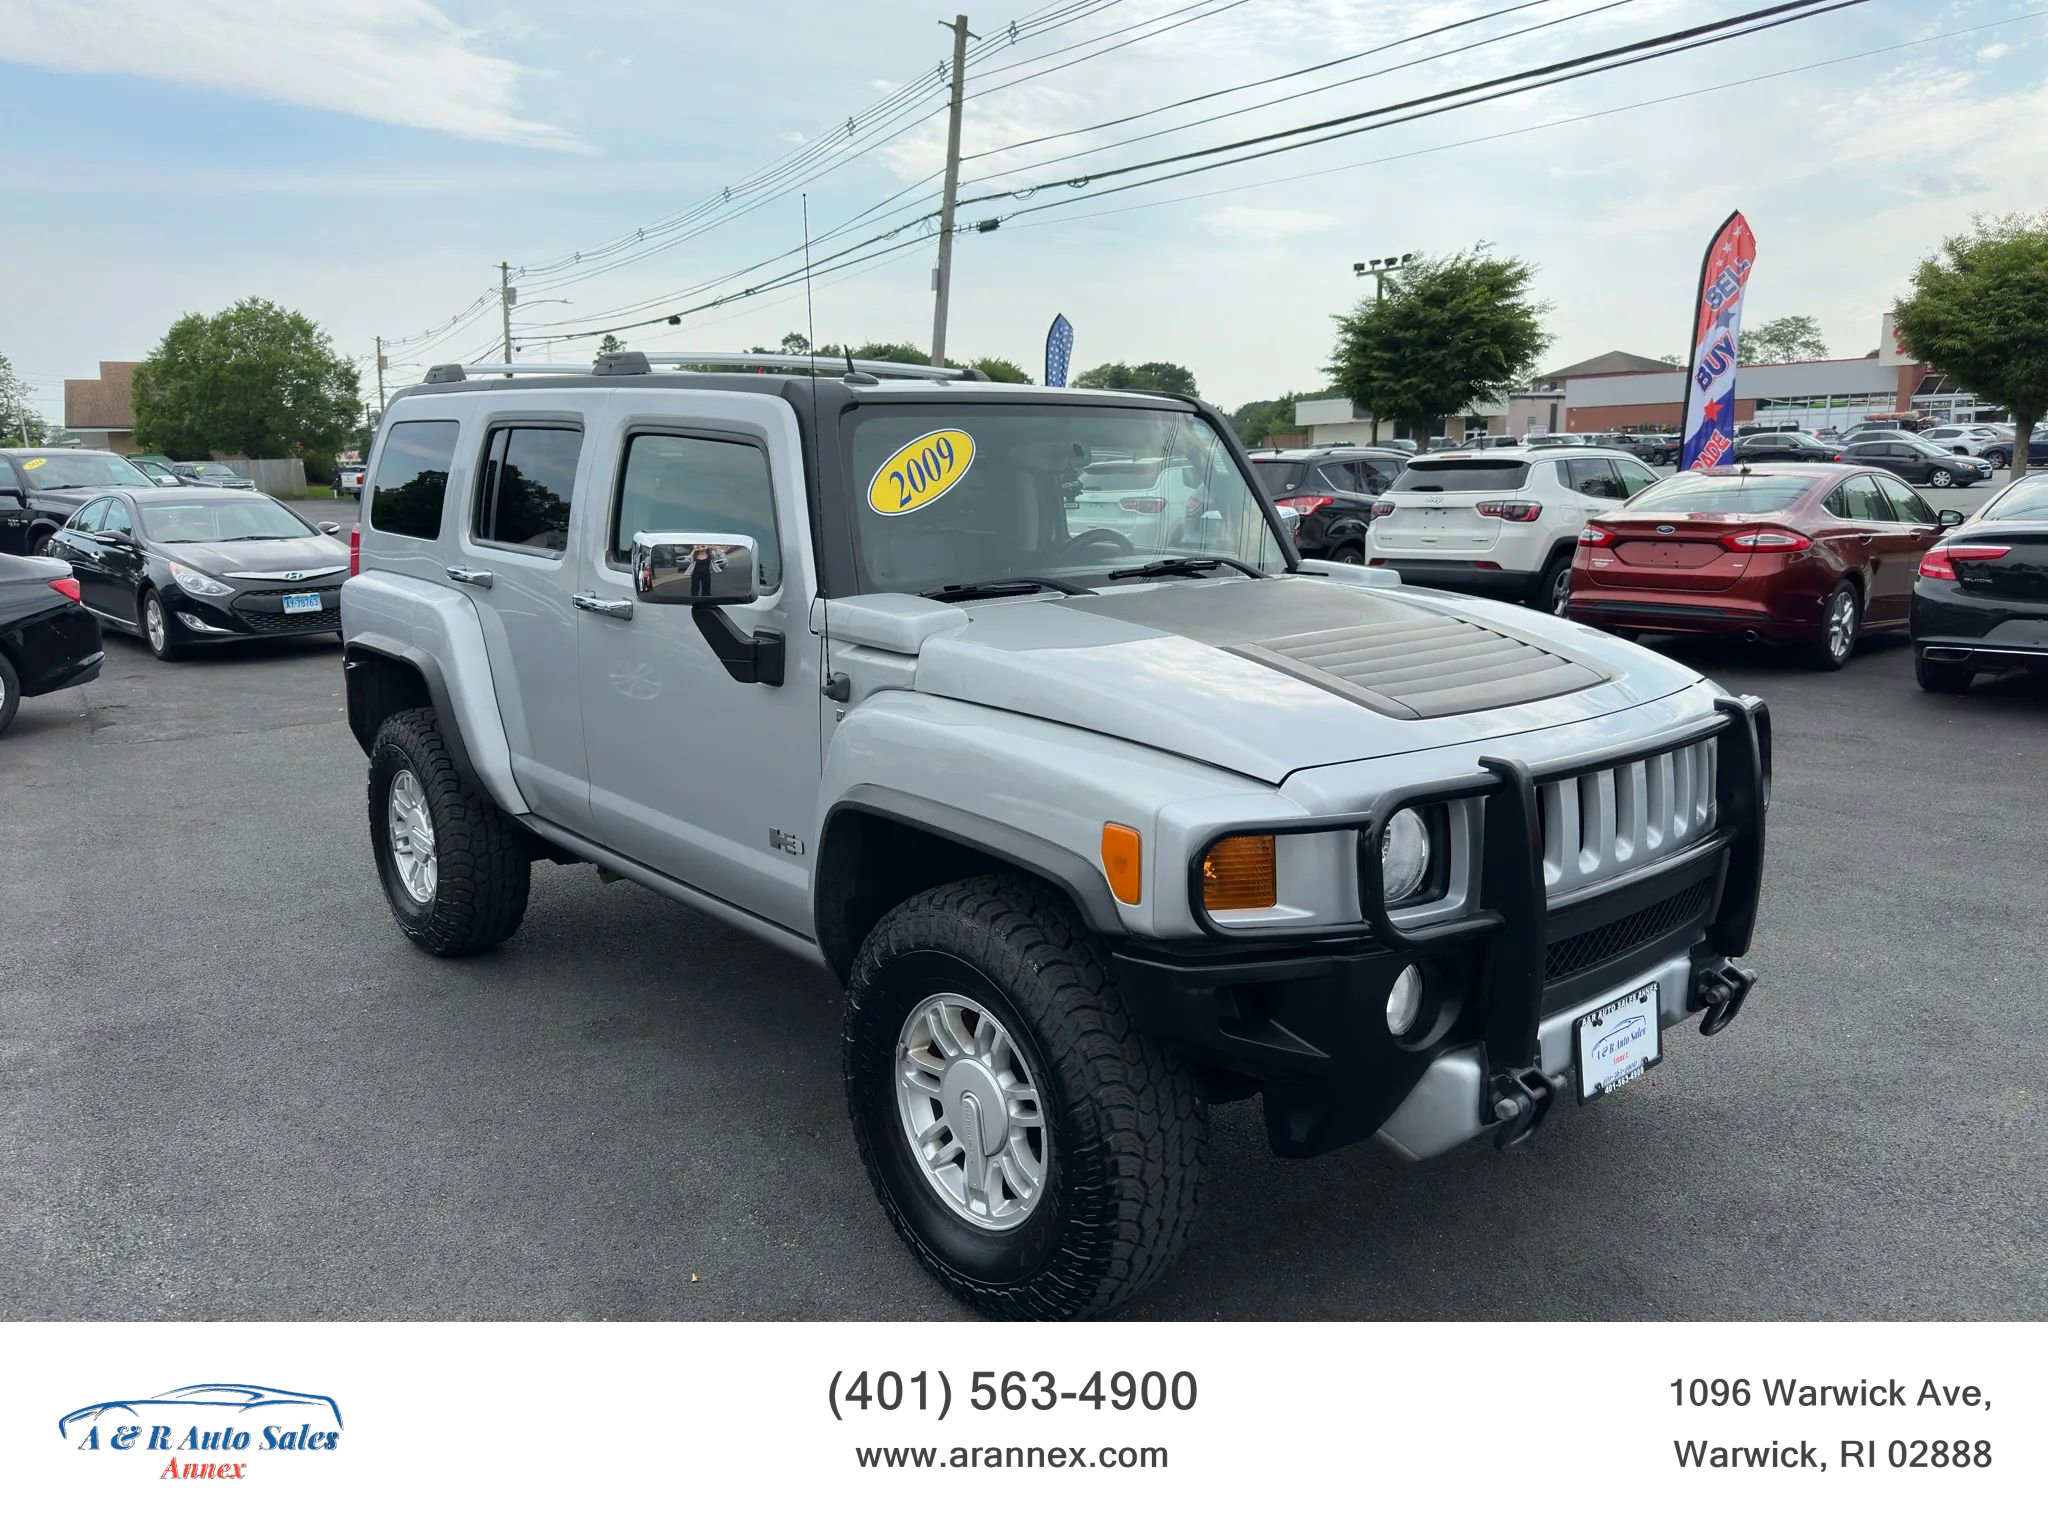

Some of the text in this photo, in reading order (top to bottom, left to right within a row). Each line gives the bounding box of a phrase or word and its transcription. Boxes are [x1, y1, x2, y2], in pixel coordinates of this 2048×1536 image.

[1695, 332, 1735, 393] BUY
[889, 437, 954, 508] 2009
[769, 826, 804, 855] H3
[1598, 1004, 1617, 1019] AUTO
[1618, 994, 1637, 1009] SALES
[1638, 984, 1659, 999] ANNEX
[1631, 1026, 1647, 1043] Sales
